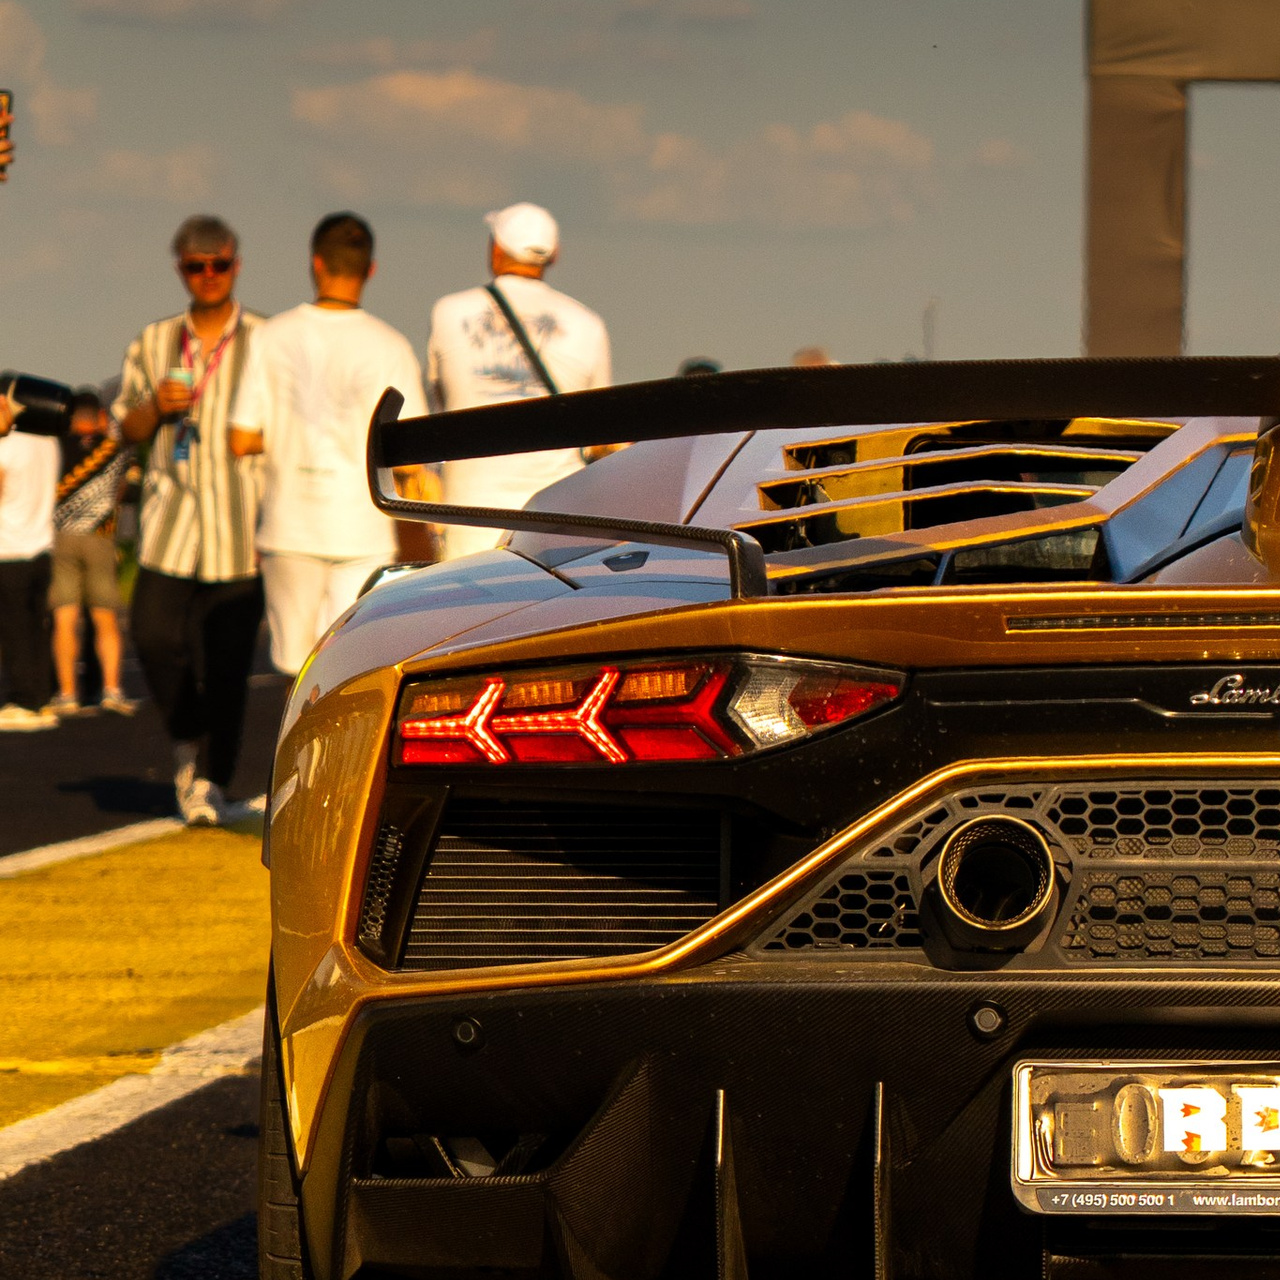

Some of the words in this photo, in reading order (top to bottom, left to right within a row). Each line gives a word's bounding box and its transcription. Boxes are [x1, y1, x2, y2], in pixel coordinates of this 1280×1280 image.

[1051, 1195, 1069, 1206] +7
[1071, 1193, 1107, 1208] (495)
[1109, 1194, 1136, 1207] 500
[1138, 1194, 1165, 1207] 500
